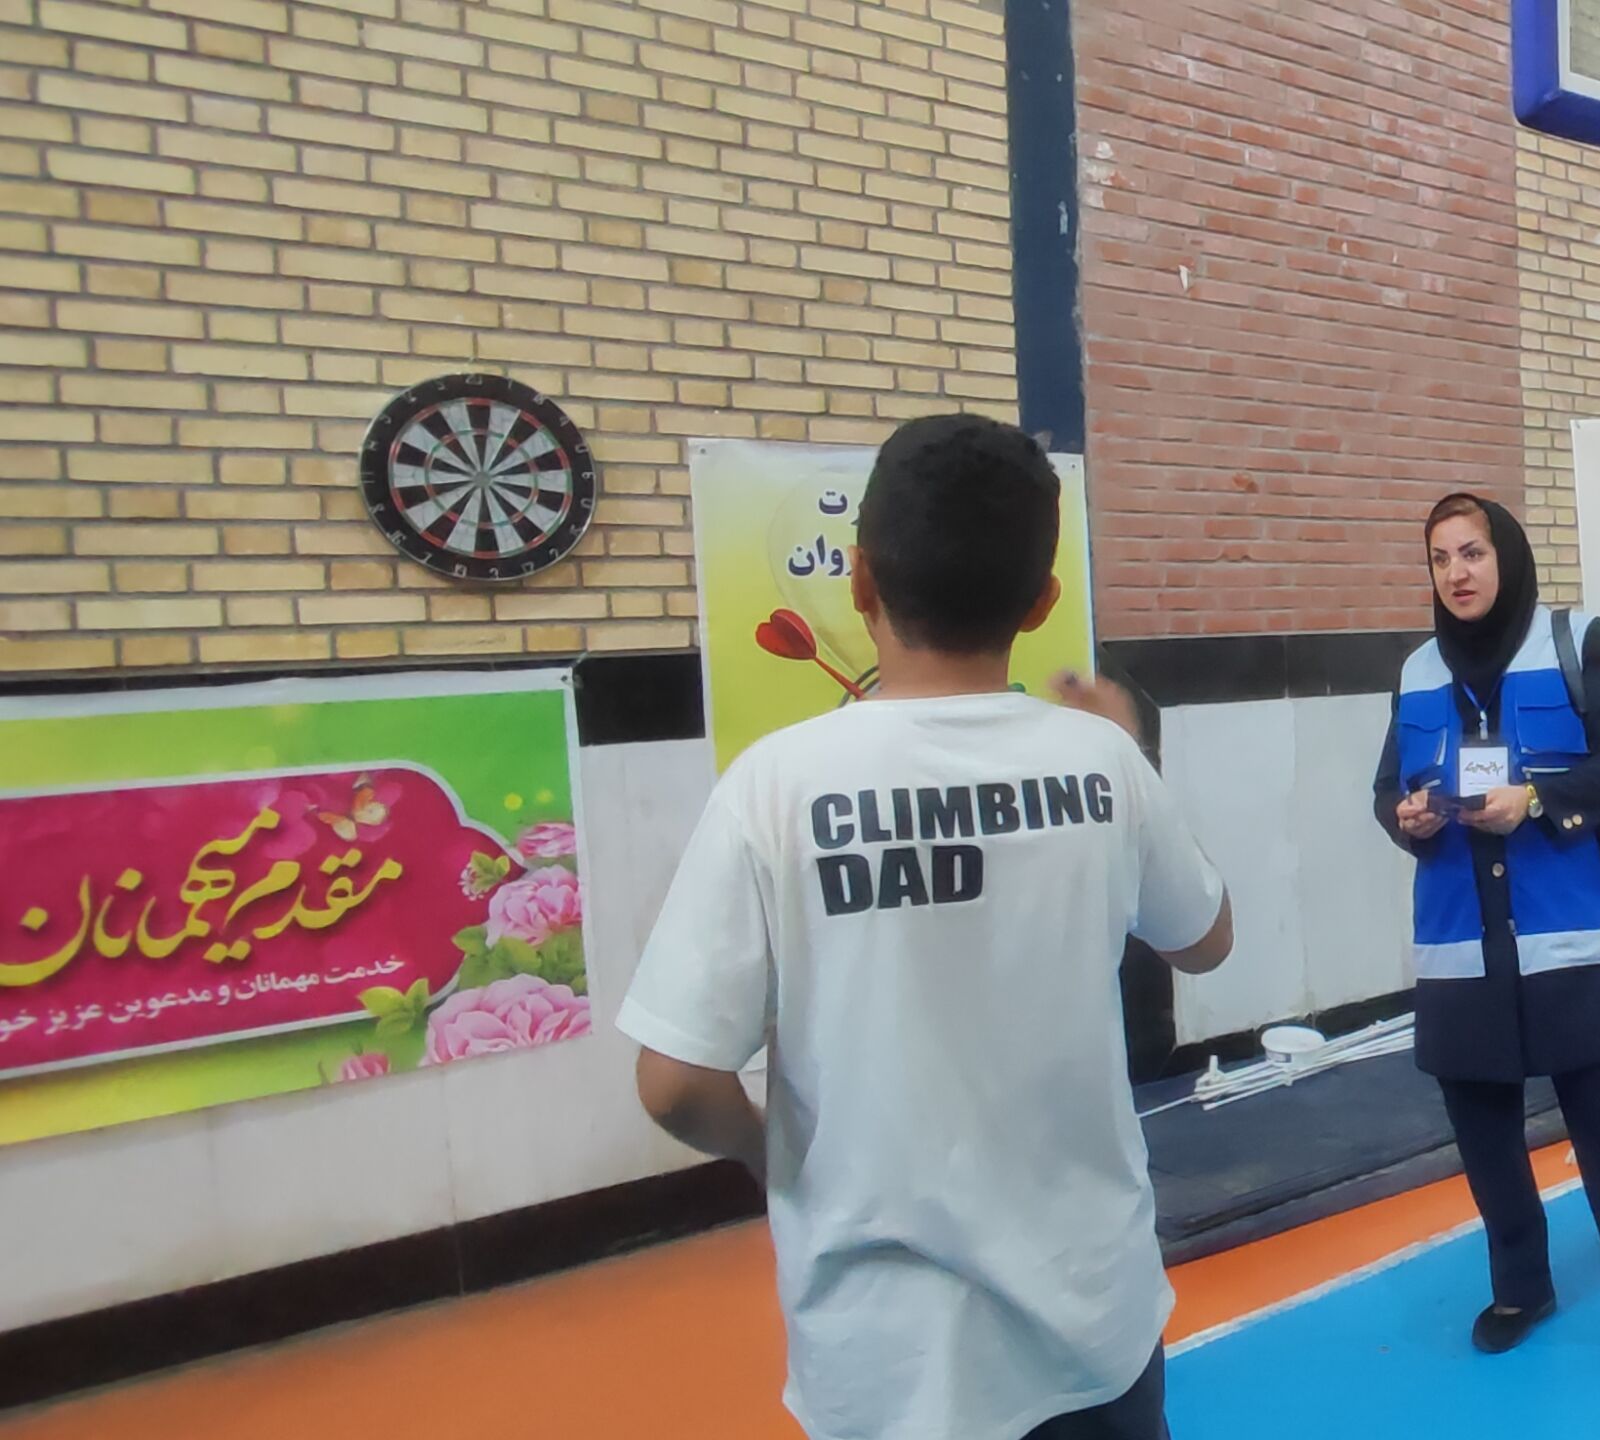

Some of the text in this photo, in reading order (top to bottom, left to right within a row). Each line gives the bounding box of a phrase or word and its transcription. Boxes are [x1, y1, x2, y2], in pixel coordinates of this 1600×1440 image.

[811, 773, 1113, 850] CLIMBING
[816, 844, 984, 916] DAD
[323, 954, 405, 985] خدمت
[216, 984, 231, 1005] و
[234, 972, 320, 1000] مهمانان
[44, 1003, 103, 1035] عزیز
[108, 988, 213, 1024] مدعوین
